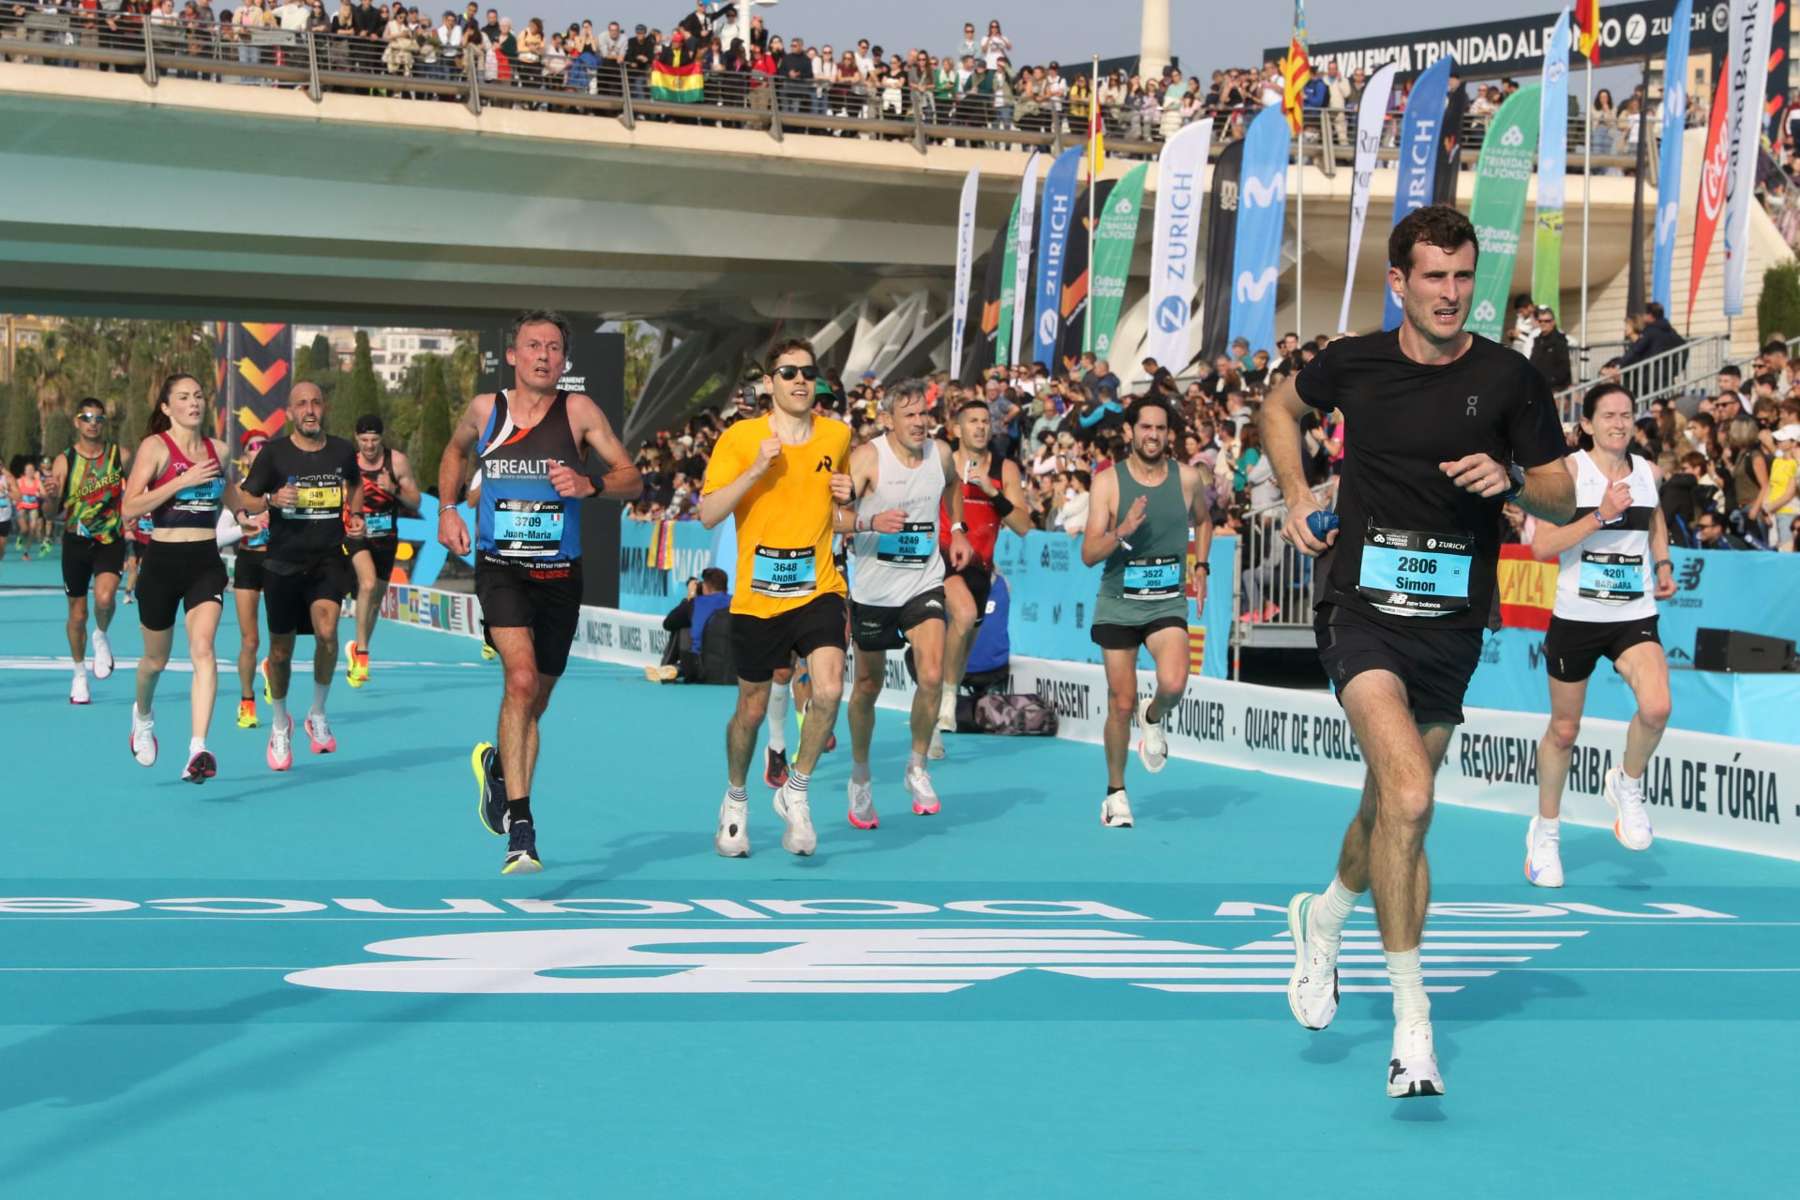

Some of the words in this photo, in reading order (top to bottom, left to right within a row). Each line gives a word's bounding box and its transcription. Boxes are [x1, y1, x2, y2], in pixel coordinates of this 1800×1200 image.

[1651, 12, 1706, 36] ZUCH
[1414, 33, 1513, 70] TRINIDAD
[1513, 18, 1621, 59] ALFO
[1485, 155, 1532, 170] TRINIDAD
[1482, 167, 1529, 181] ALFONSO
[1168, 173, 1193, 280] ZURICH
[500, 459, 565, 474] REALIT
[514, 516, 542, 527] 3709
[503, 529, 552, 539] Juan-Maria
[1438, 541, 1466, 550] ZURICH
[773, 562, 798, 572] 3648
[1397, 556, 1438, 574] 2806
[1602, 568, 1626, 579] 4201
[1395, 576, 1436, 592] Simon
[1244, 706, 1289, 752] QUART
[1291, 713, 1309, 756] DE
[1314, 719, 1361, 762] POBLE
[1461, 733, 1539, 786] REQUENA
[1682, 759, 1707, 812] DE
[1715, 752, 1780, 825] TÚRIA
